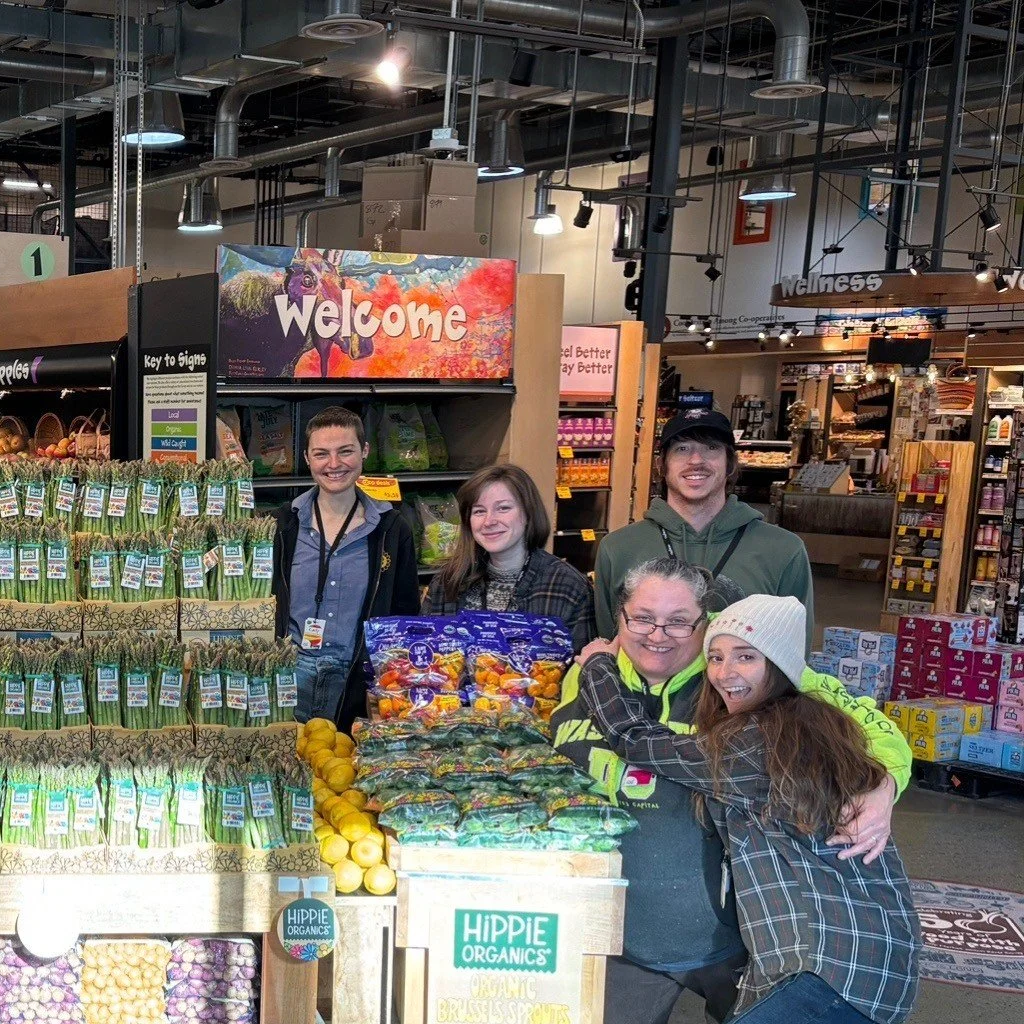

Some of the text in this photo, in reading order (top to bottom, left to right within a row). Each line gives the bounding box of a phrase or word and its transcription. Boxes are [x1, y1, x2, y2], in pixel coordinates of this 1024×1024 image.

[30, 247, 43, 276] 1
[781, 273, 883, 298] Wellness
[274, 289, 468, 342] Welcome
[144, 354, 162, 372] Key
[164, 353, 176, 368] to
[178, 350, 207, 372] Signs
[575, 346, 611, 359] Better
[577, 361, 613, 375] Better
[168, 411, 180, 419] Local
[160, 439, 187, 449] Wild Caught
[287, 908, 329, 925] HIPPIE
[287, 925, 331, 936] ORGANICS
[463, 913, 550, 947] HIPPIE
[461, 947, 551, 967] ORGANICS
[470, 975, 537, 998] ORGANIC
[436, 1000, 503, 1024] BRUSSELS
